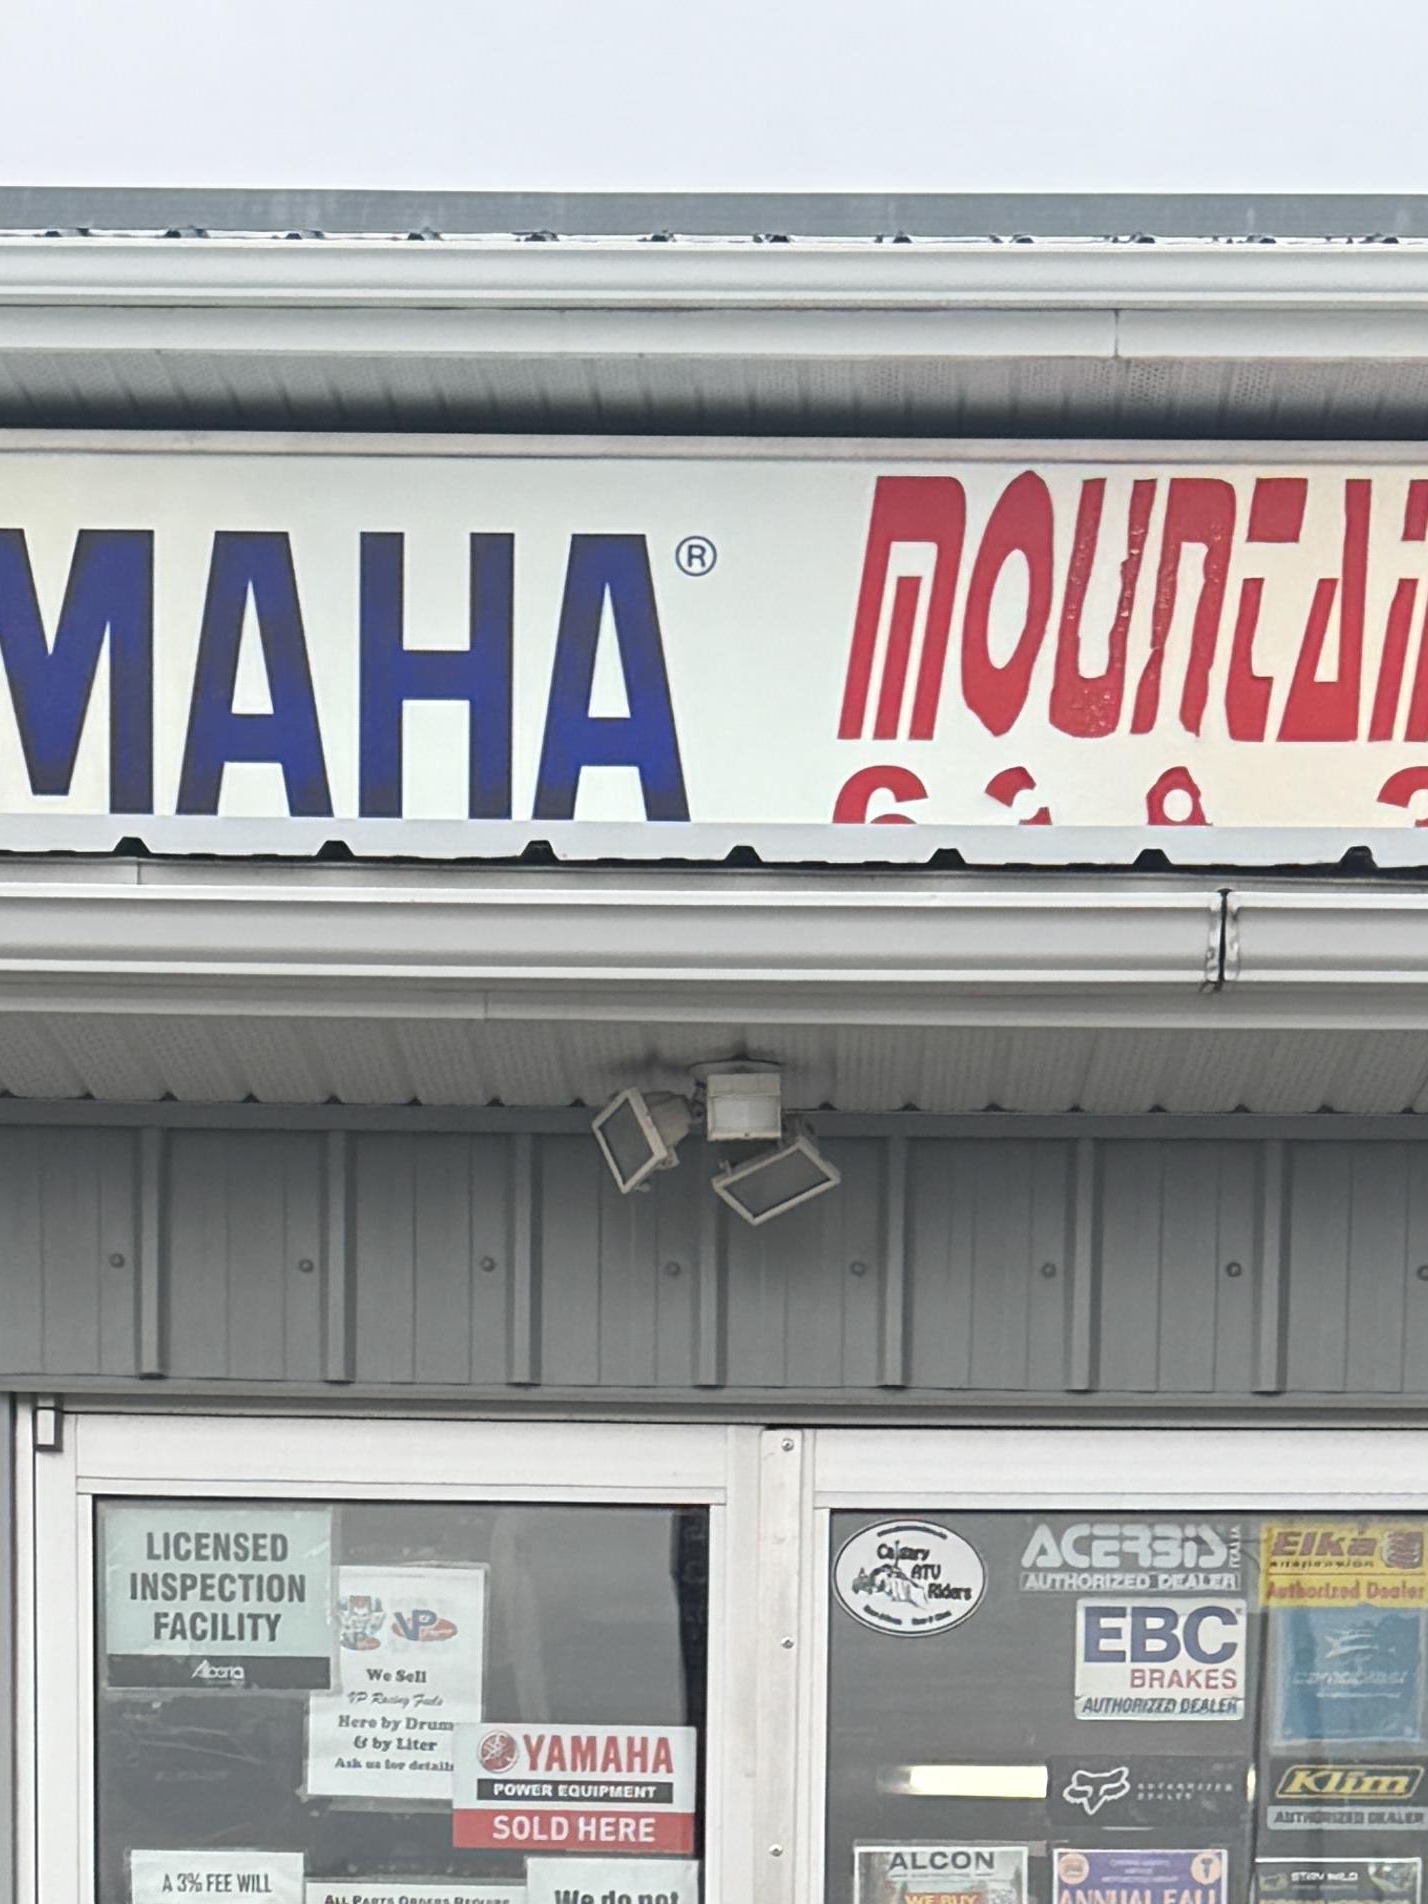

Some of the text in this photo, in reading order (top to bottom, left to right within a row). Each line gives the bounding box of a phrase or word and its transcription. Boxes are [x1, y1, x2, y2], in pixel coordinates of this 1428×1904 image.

[146, 1531, 289, 1562] LICENSED
[130, 1572, 306, 1603] INSPECTION
[1025, 1573, 1236, 1589] AUTHORIZED DEALER
[1267, 1580, 1425, 1600] Authorized Dealer
[153, 1611, 283, 1642] FACILITY
[1084, 1605, 1238, 1664] EBC
[366, 1668, 427, 1684] We Sell
[1130, 1668, 1237, 1689] BRAKES
[1083, 1697, 1237, 1714] AUTHORIZED DEALER
[338, 1715, 454, 1732] Here by Drum
[372, 1737, 392, 1752] by
[396, 1738, 438, 1751] Liter
[523, 1734, 674, 1774] YAMAHA
[335, 1757, 362, 1769] Ask
[493, 1783, 657, 1799] POWER EQUIPMENT
[492, 1815, 656, 1842] SOLD HERE
[889, 1852, 994, 1869] ALCON
[162, 1873, 272, 1893] A 3% FEE WILL
